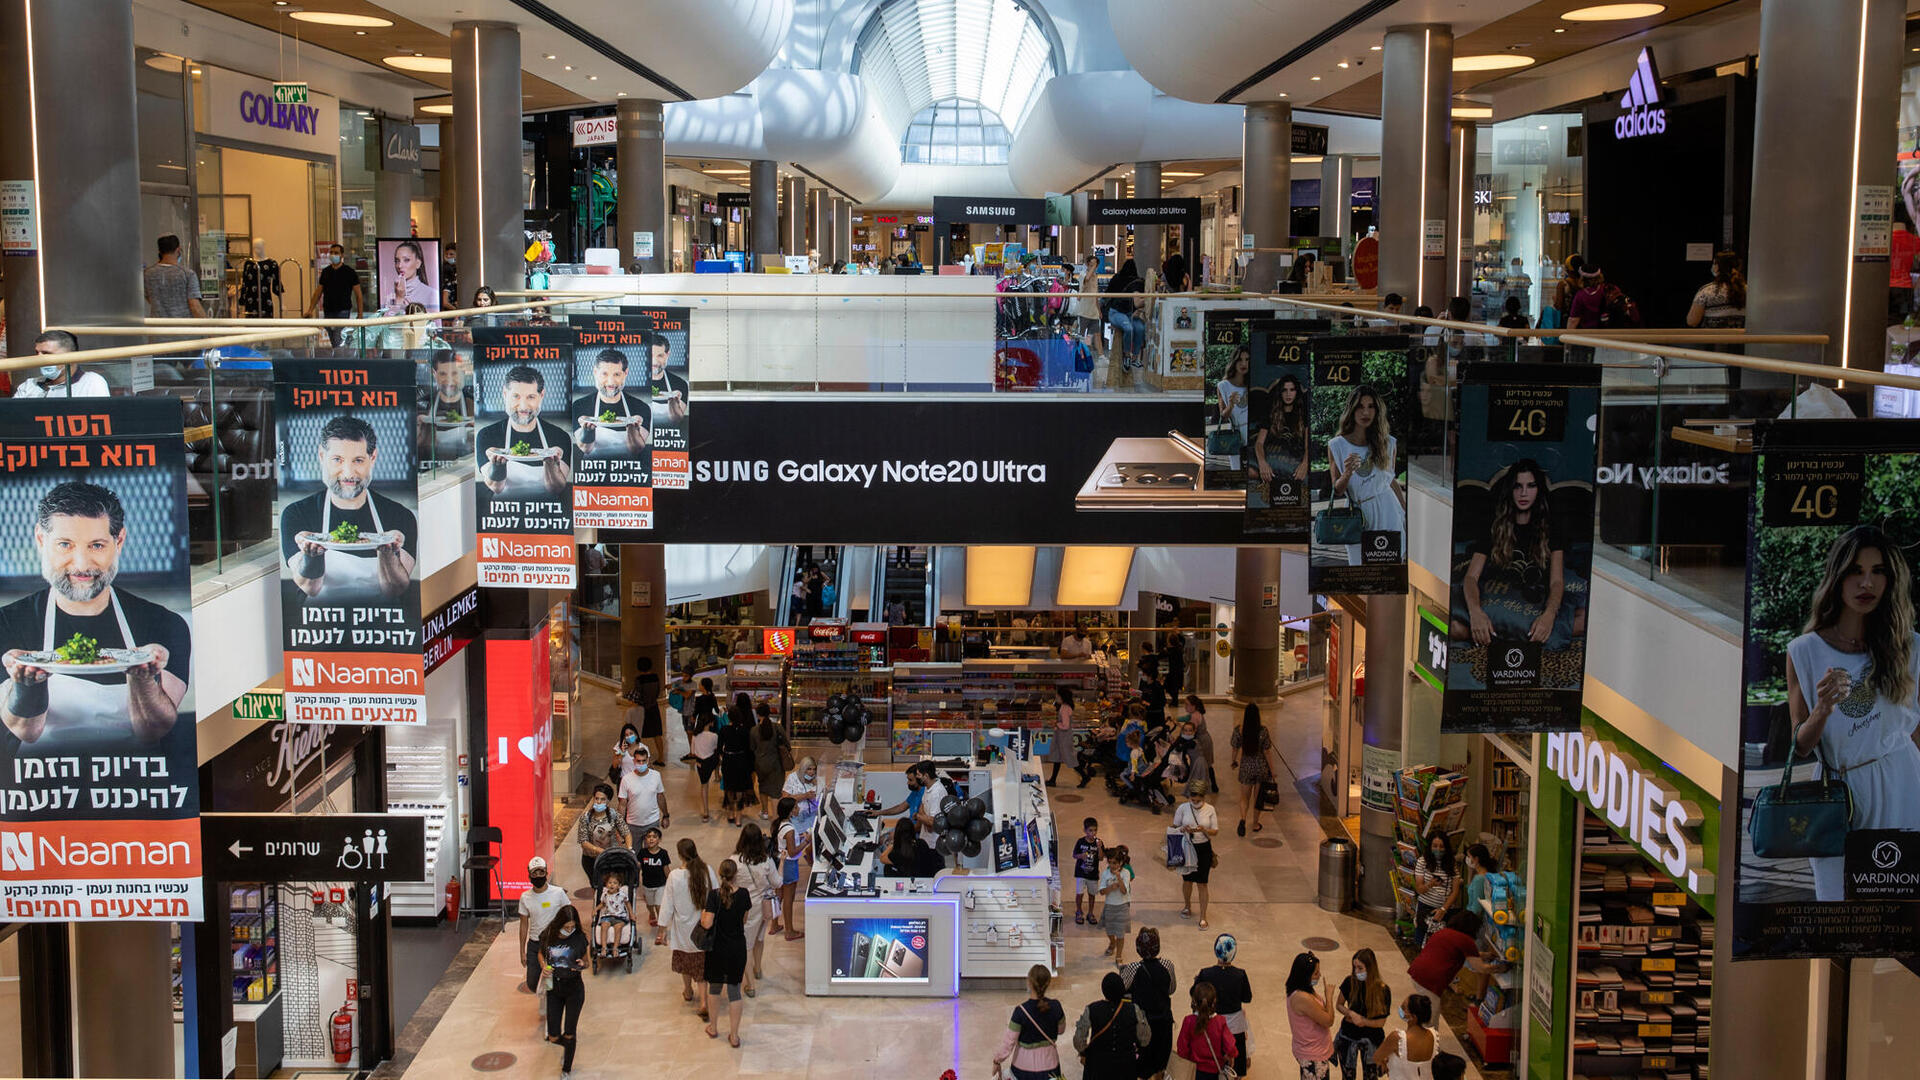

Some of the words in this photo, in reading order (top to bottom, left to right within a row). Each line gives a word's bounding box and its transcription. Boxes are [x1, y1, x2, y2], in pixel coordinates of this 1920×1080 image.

[280, 86, 306, 102] יציאה
[240, 90, 320, 135] GOLBARY
[587, 120, 617, 134] DAIS
[1615, 104, 1666, 140] adidas
[387, 132, 419, 161] Clarks
[966, 206, 1016, 216] SAMSUNG
[1102, 208, 1129, 216] Galaxy
[1130, 207, 1156, 215] Note20
[596, 321, 625, 331] הסוד
[662, 321, 681, 330] הוא
[505, 333, 540, 346] הסוד
[579, 332, 616, 345] בדיוק!
[619, 333, 642, 344] הוא
[486, 346, 529, 361] בדיוק!
[533, 347, 560, 359] הוא
[320, 370, 369, 385] הסוד
[293, 387, 355, 408] בדיוק!
[361, 390, 398, 407] הוא
[35, 414, 112, 437] הסוד
[654, 428, 680, 438] בדיוק
[653, 439, 686, 449] להיכנס
[101, 444, 156, 467] הוא
[581, 459, 608, 471] הזמן
[611, 460, 642, 472] בדיוק
[1787, 461, 1818, 470] בורדינון
[1821, 461, 1845, 469] עכשיו
[574, 471, 607, 484] לנעמן
[610, 473, 649, 483] להיכנס
[688, 460, 769, 482] SUNG
[777, 460, 878, 488] Galaxy
[882, 460, 977, 483] Note20
[982, 460, 1046, 483] Ultra
[1805, 473, 1823, 481] מיקי
[588, 493, 649, 507] Naaman
[490, 501, 520, 515] הזמן
[525, 502, 562, 515] בדיוק
[482, 514, 520, 530] לנעמן
[524, 516, 571, 530] להיכנס
[575, 517, 606, 527] חמים!
[608, 518, 648, 528] מבצעים
[500, 541, 571, 558] Naaman
[484, 572, 519, 583] חמים!
[524, 572, 570, 585] מבצעים
[447, 590, 477, 626] LEMKE
[302, 607, 345, 625] הזמן
[353, 608, 405, 625] בדיוק
[291, 628, 344, 646] לנעמן
[352, 628, 416, 646] להיכנס
[423, 635, 453, 671] BERLIN
[317, 662, 418, 686] Naaman
[1492, 670, 1535, 679] VARDINON
[242, 695, 281, 718] יציאה
[294, 696, 317, 705] קרקע
[319, 697, 340, 706] קומת
[349, 697, 367, 706] נעמן
[369, 697, 393, 705] בחנות
[296, 706, 346, 721] חמים!
[352, 707, 417, 722] מבצעים
[14, 756, 80, 783] הזמן
[91, 756, 169, 782] בדיוק
[0, 785, 80, 814] לנעמן
[90, 784, 188, 809] להיכנס
[1547, 732, 1698, 894] HOODIES.
[39, 836, 190, 866] Naaman
[265, 841, 320, 856] שרותים
[999, 843, 1013, 857] 5G
[642, 857, 662, 866] FILA
[1853, 873, 1920, 885] VARDINON
[4, 885, 38, 897] קרקע
[42, 884, 73, 897] קומת
[86, 883, 112, 896] נעמן
[116, 884, 151, 894] בחנות
[155, 883, 188, 894] עכשיו
[6, 898, 81, 918] חמים!
[91, 898, 189, 918] מבצעים
[1656, 927, 1673, 937] NEW
